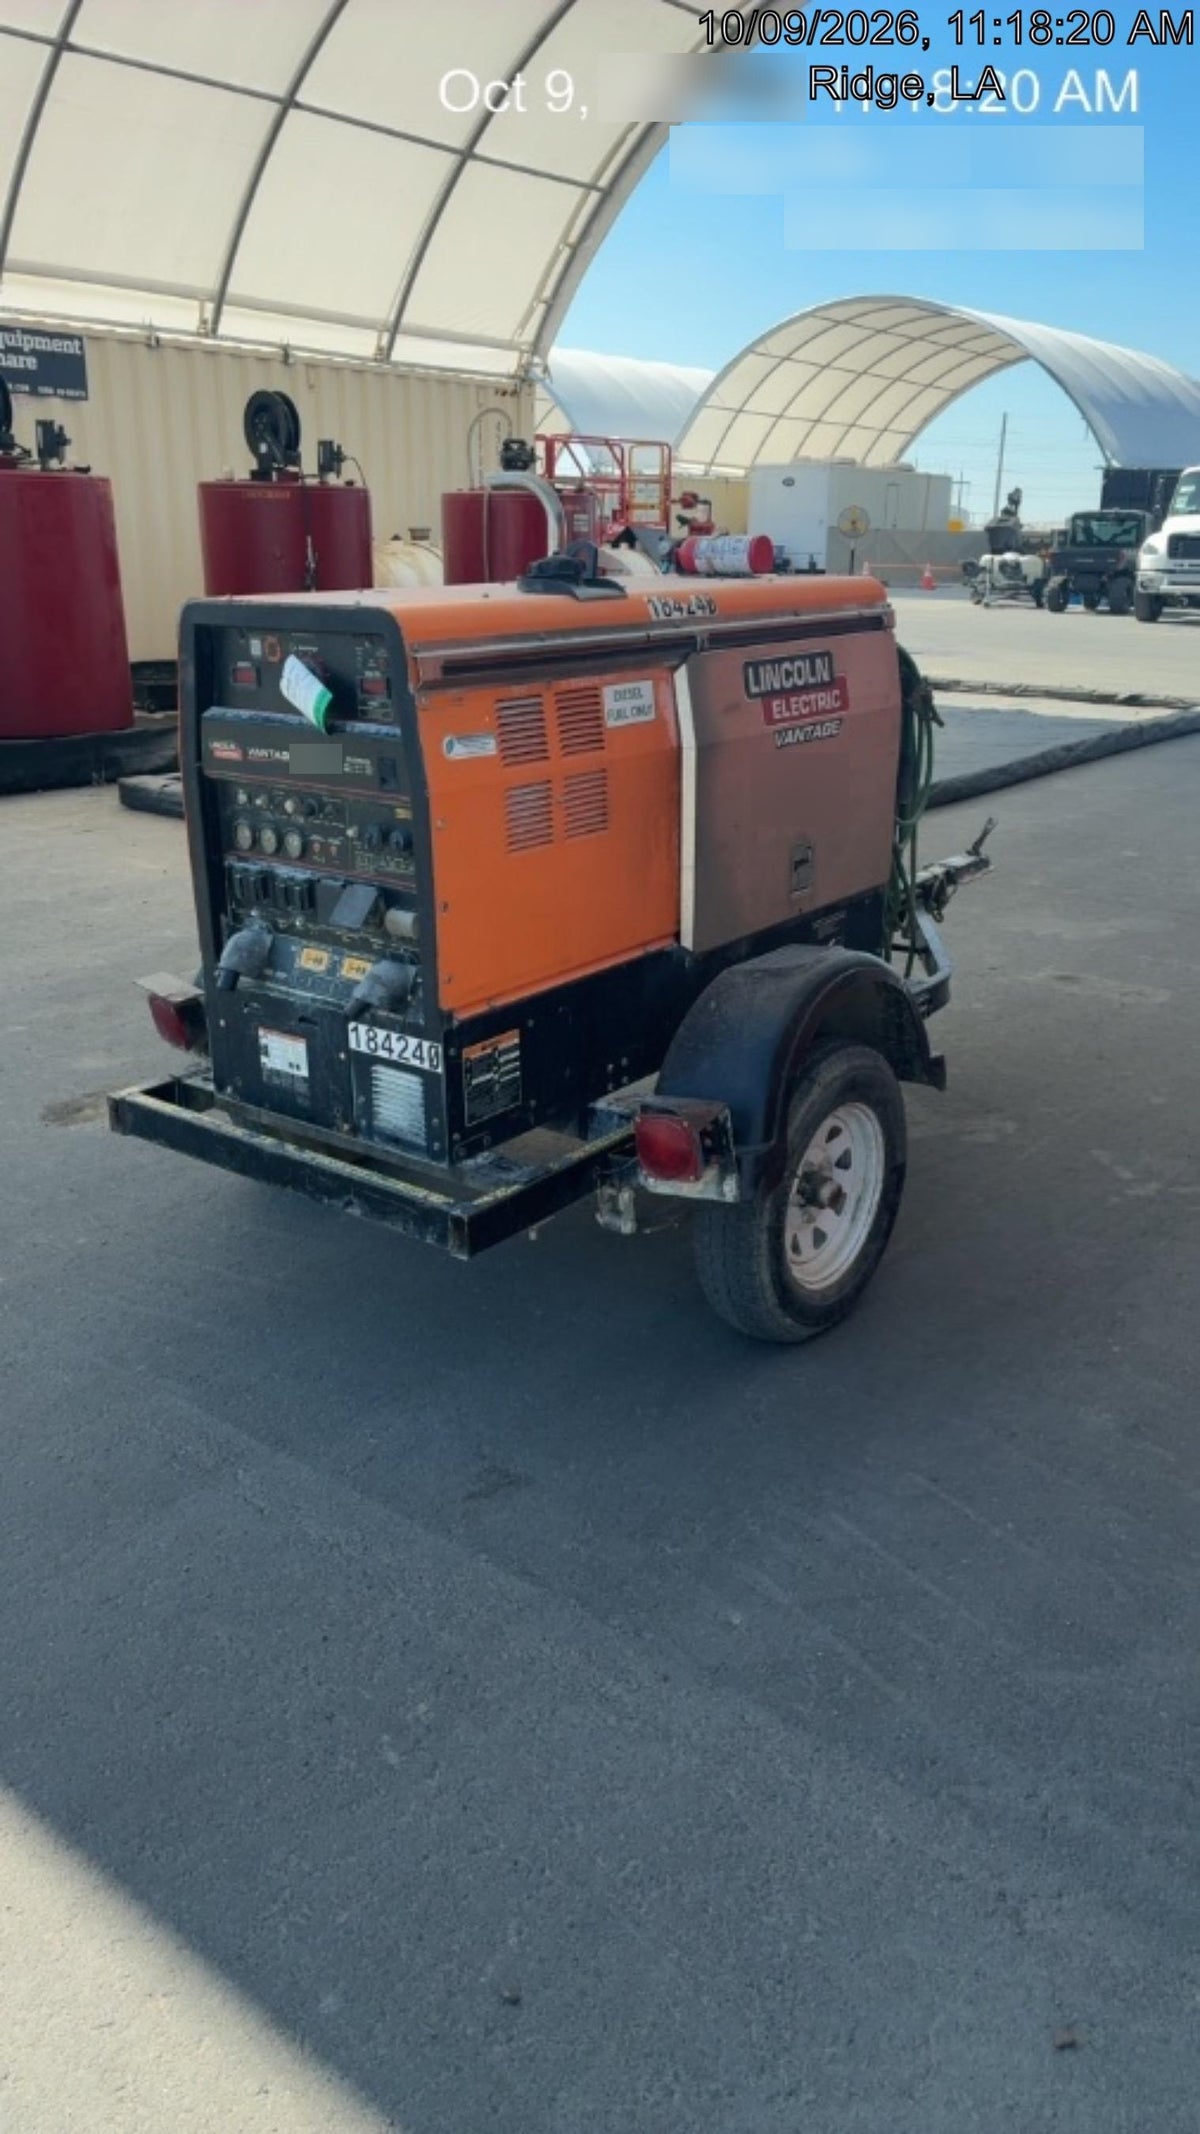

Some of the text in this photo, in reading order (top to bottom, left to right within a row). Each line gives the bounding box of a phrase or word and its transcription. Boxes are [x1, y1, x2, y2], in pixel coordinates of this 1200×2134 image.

[747, 656, 831, 694] LINCOLN
[772, 689, 841, 719] ELECTRIC
[774, 719, 842, 749] VANTAGE
[350, 1023, 440, 1070] 184240
